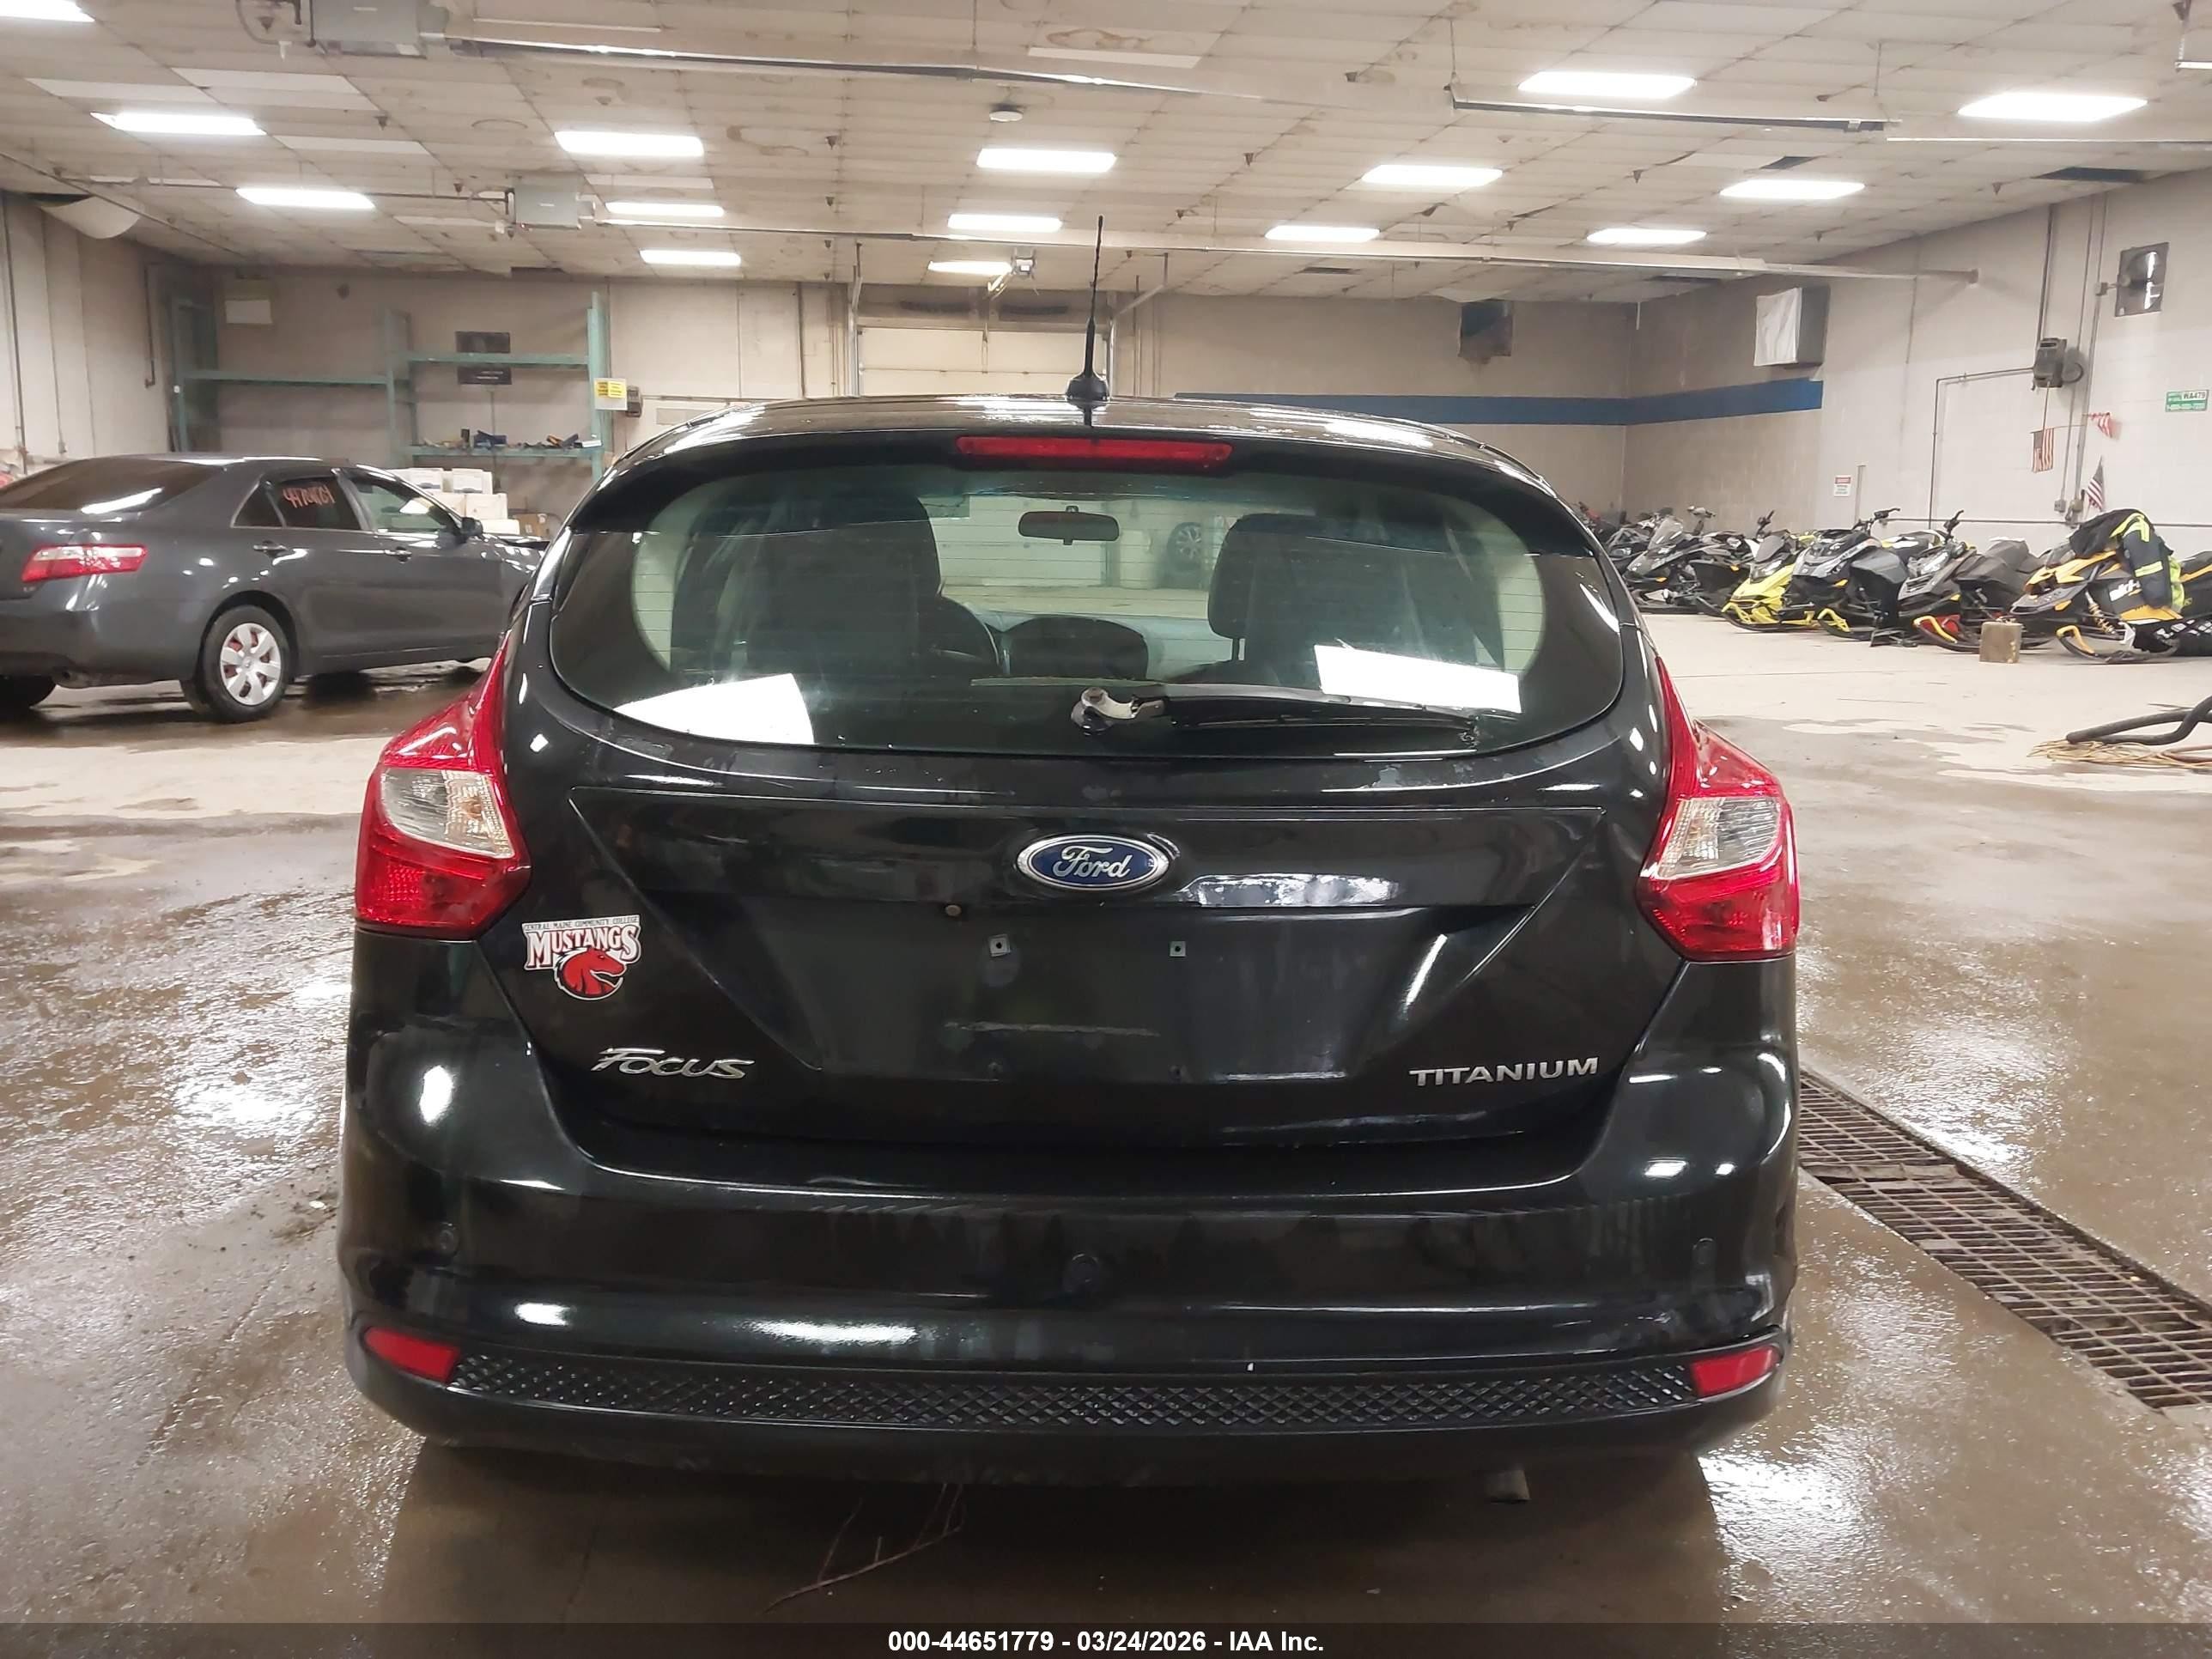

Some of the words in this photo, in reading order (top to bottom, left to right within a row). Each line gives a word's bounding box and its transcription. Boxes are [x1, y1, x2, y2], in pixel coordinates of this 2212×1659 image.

[1053, 845, 1133, 878] Ford
[553, 921, 573, 929] MAINE
[612, 915, 638, 925] COLLEGE
[526, 925, 640, 968] MUSTANGS
[1409, 1056, 1599, 1086] TITANIUM
